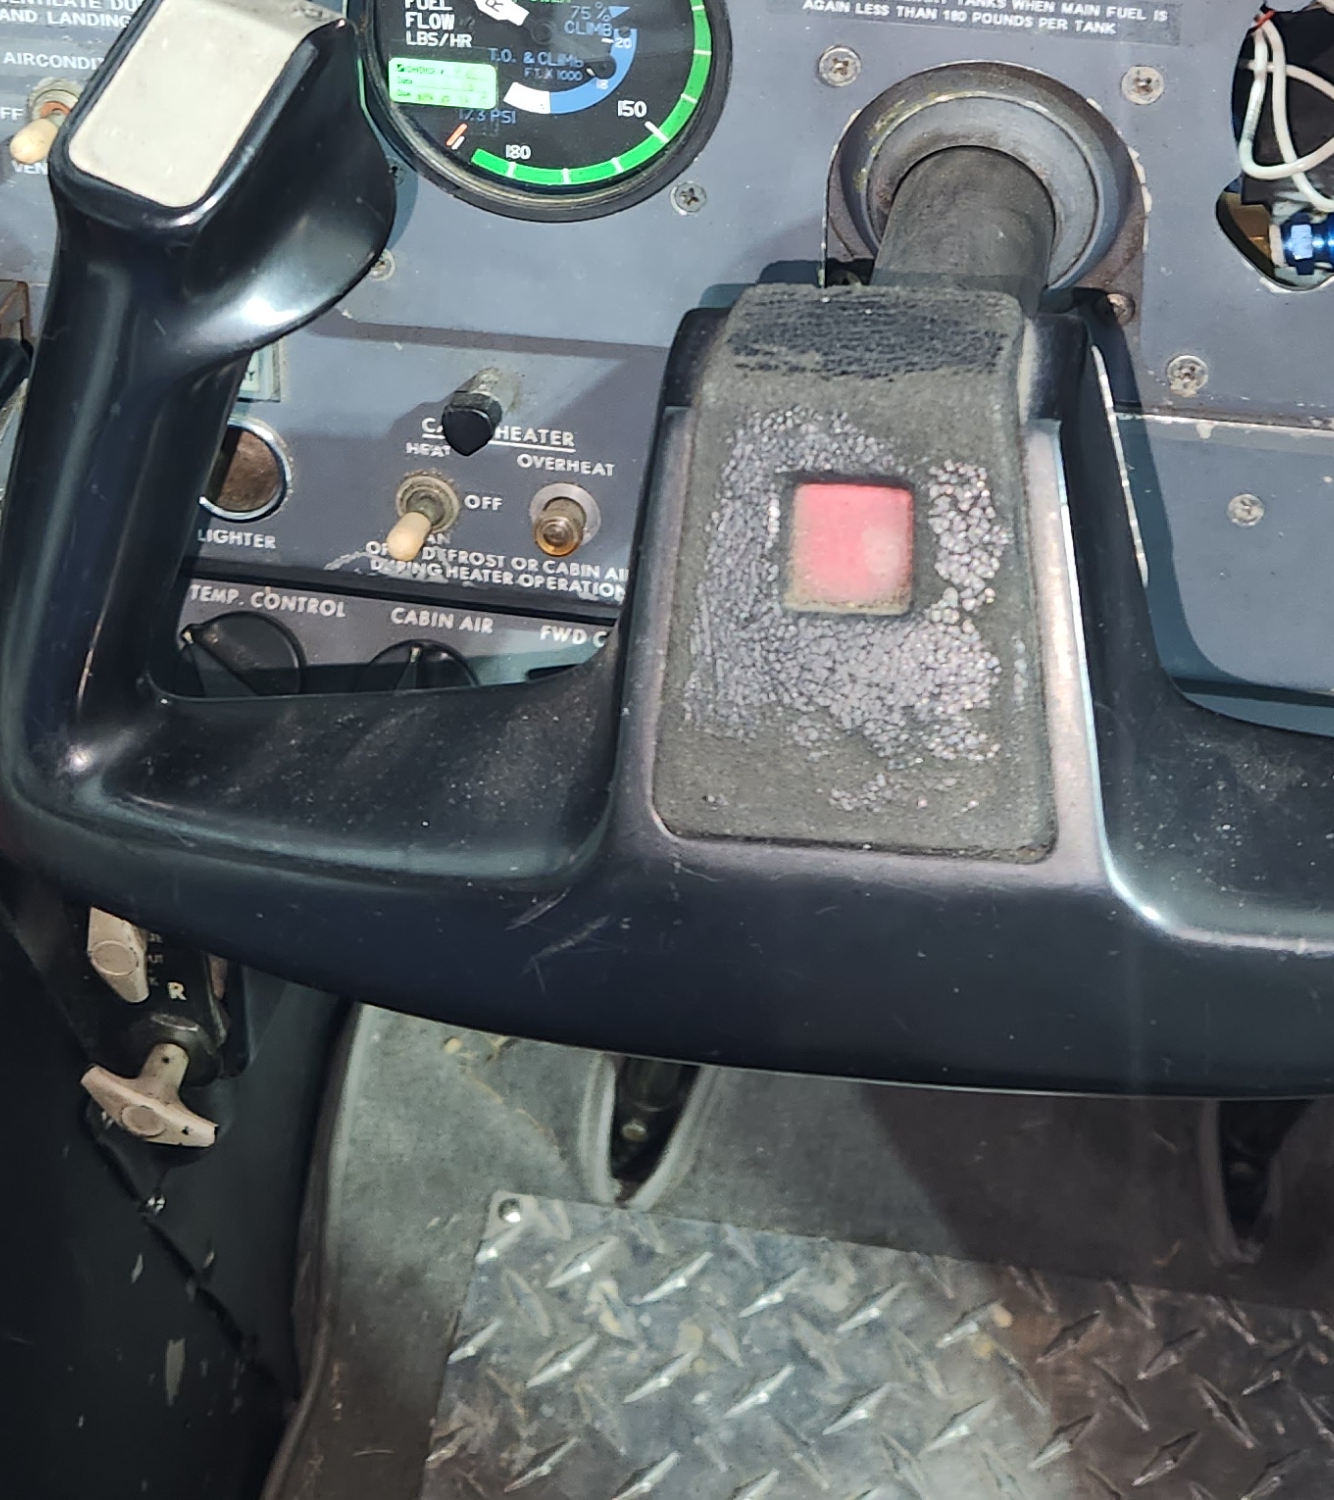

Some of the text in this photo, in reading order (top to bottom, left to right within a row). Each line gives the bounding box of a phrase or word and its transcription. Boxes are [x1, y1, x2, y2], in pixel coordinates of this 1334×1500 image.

[47, 11, 131, 28] LANDING
[406, 12, 454, 30] FLOW
[803, 0, 1116, 35] AGAIN LESS THAN POUNDS PER TANK
[1061, 1, 1101, 17] MAIN
[1106, 6, 1146, 21] FUEL
[1154, 10, 1167, 23] IS
[407, 31, 472, 47] LBS/HR
[618, 101, 647, 117] 150
[506, 144, 531, 159] 180
[496, 428, 574, 446] HEATER
[517, 454, 613, 476] OVERHEAT
[465, 495, 502, 510] OFF
[198, 530, 276, 549] LIGHTER
[422, 548, 599, 578] DEFROST OR CABIN
[446, 568, 626, 602] HEATER OPERATION
[189, 585, 346, 617] TEMP. CONTROL
[392, 608, 492, 634] CABIN AIR
[541, 626, 588, 645] FWD
